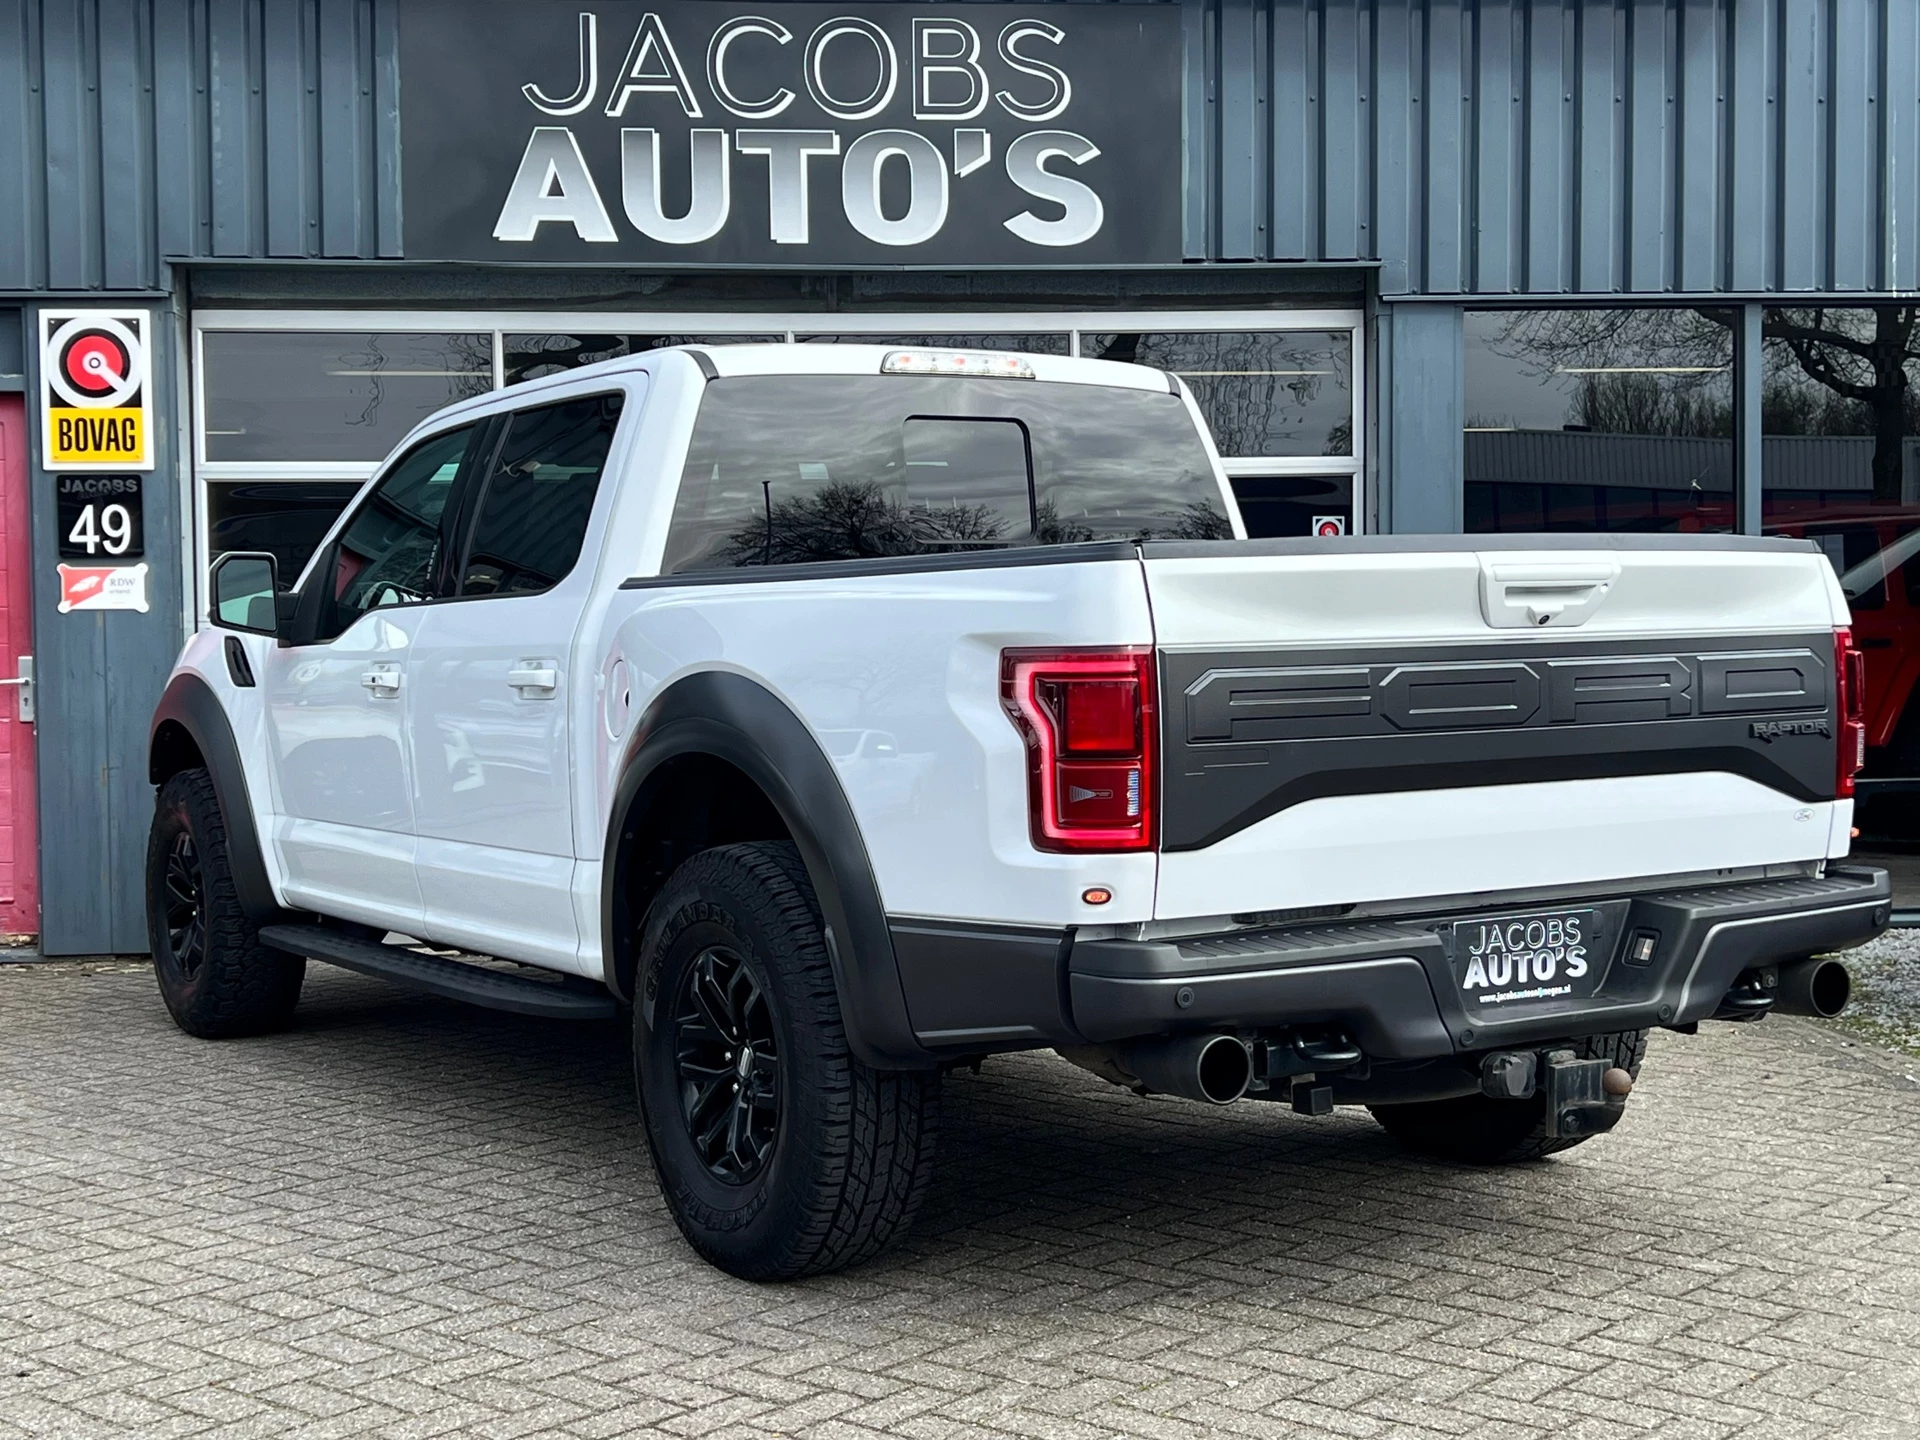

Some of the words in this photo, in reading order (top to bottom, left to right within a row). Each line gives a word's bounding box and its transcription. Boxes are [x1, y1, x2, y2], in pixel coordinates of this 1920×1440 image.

[520, 12, 1072, 120] JACOBS
[492, 127, 1104, 246] AUTO'S
[58, 418, 136, 452] BOVAG
[60, 478, 138, 493] JACOBS
[69, 504, 131, 554] 49
[109, 577, 136, 587] RDW
[1185, 647, 1828, 744] FORD
[1750, 719, 1831, 743] RAPTOR
[1468, 917, 1582, 955] JACOBS
[1462, 946, 1588, 989] AUTO'S
